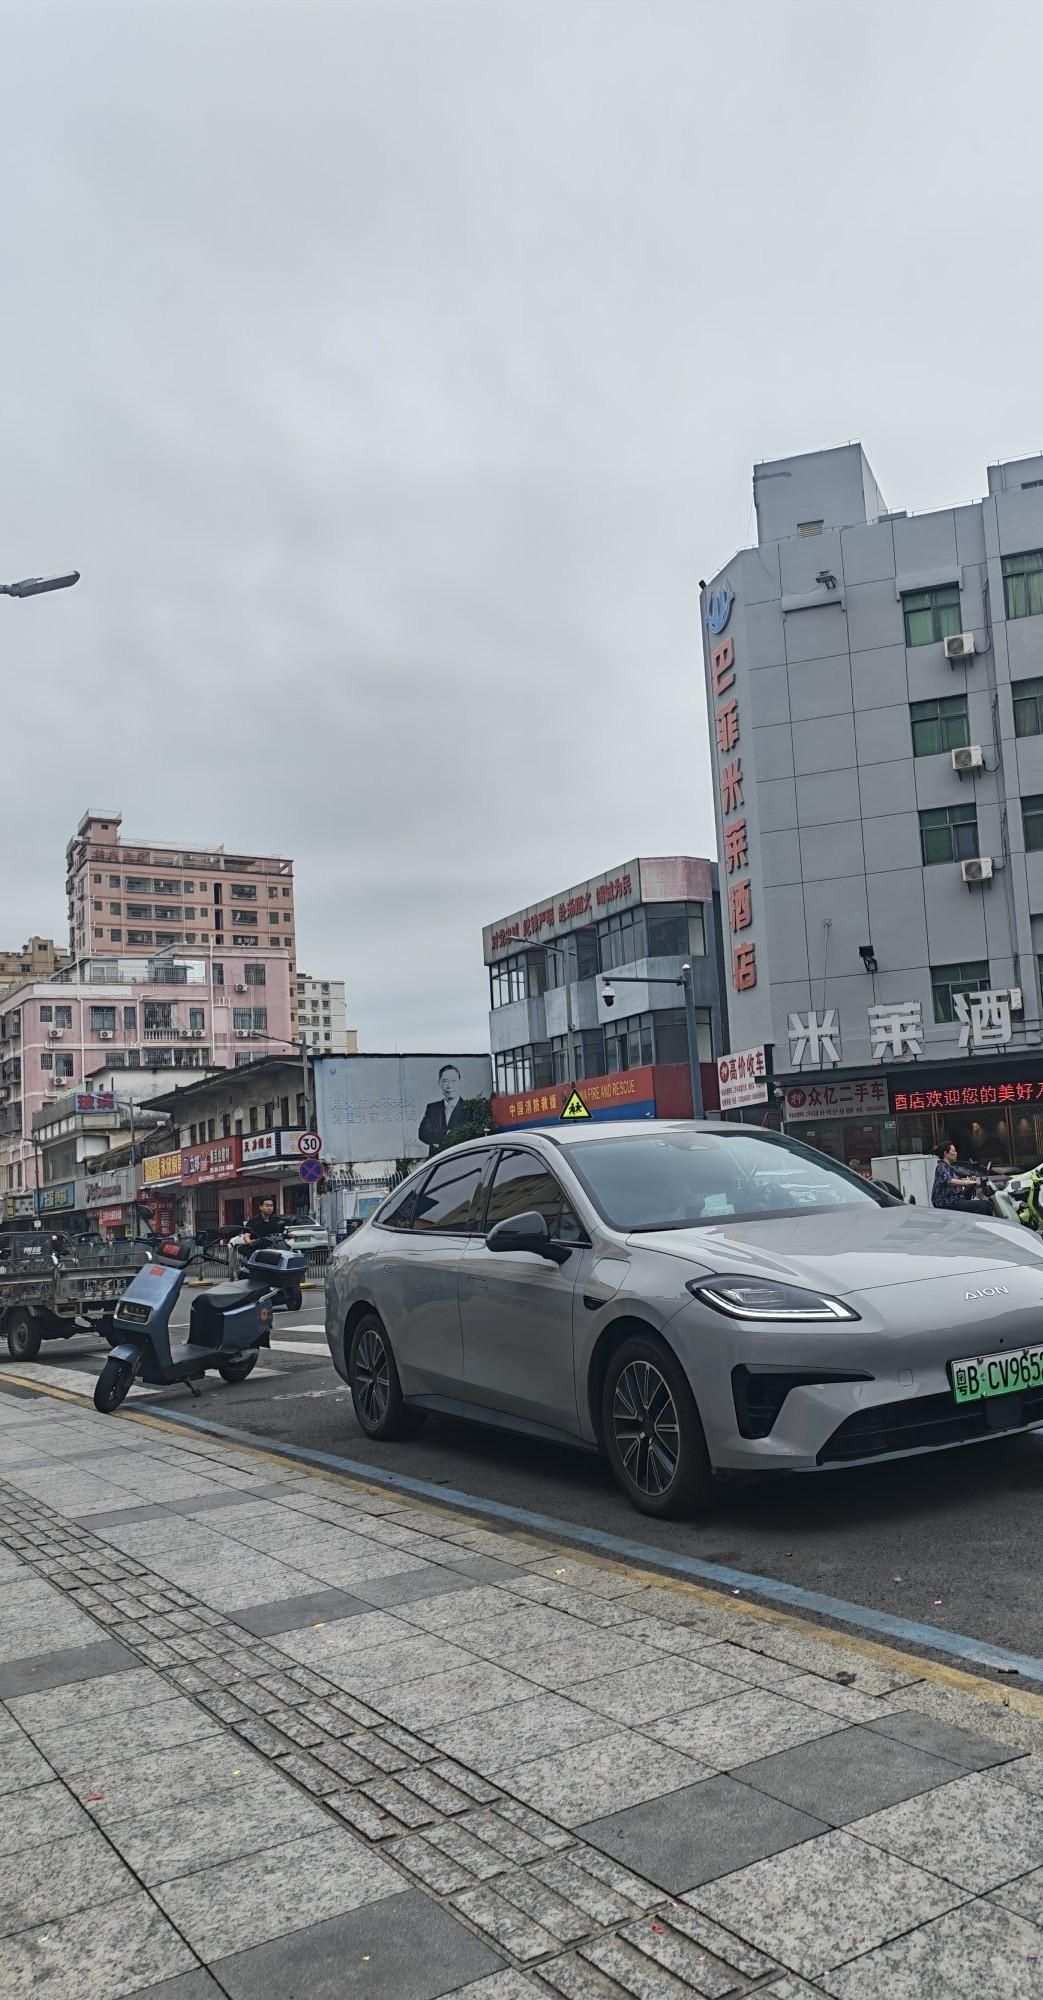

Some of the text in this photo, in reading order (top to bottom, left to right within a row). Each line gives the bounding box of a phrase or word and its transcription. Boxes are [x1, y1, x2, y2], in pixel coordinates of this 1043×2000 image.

[711, 637, 757, 992] 巴菲米莱酒店
[788, 989, 1012, 1065] 米莱酒
[729, 1051, 765, 1081] 高价收车
[612, 1080, 635, 1097] RESCUE
[808, 1082, 885, 1106] 众亿二手车
[508, 1094, 558, 1117] 中国消防救援
[303, 1138, 317, 1151] 30
[965, 1285, 1009, 1301] AION
